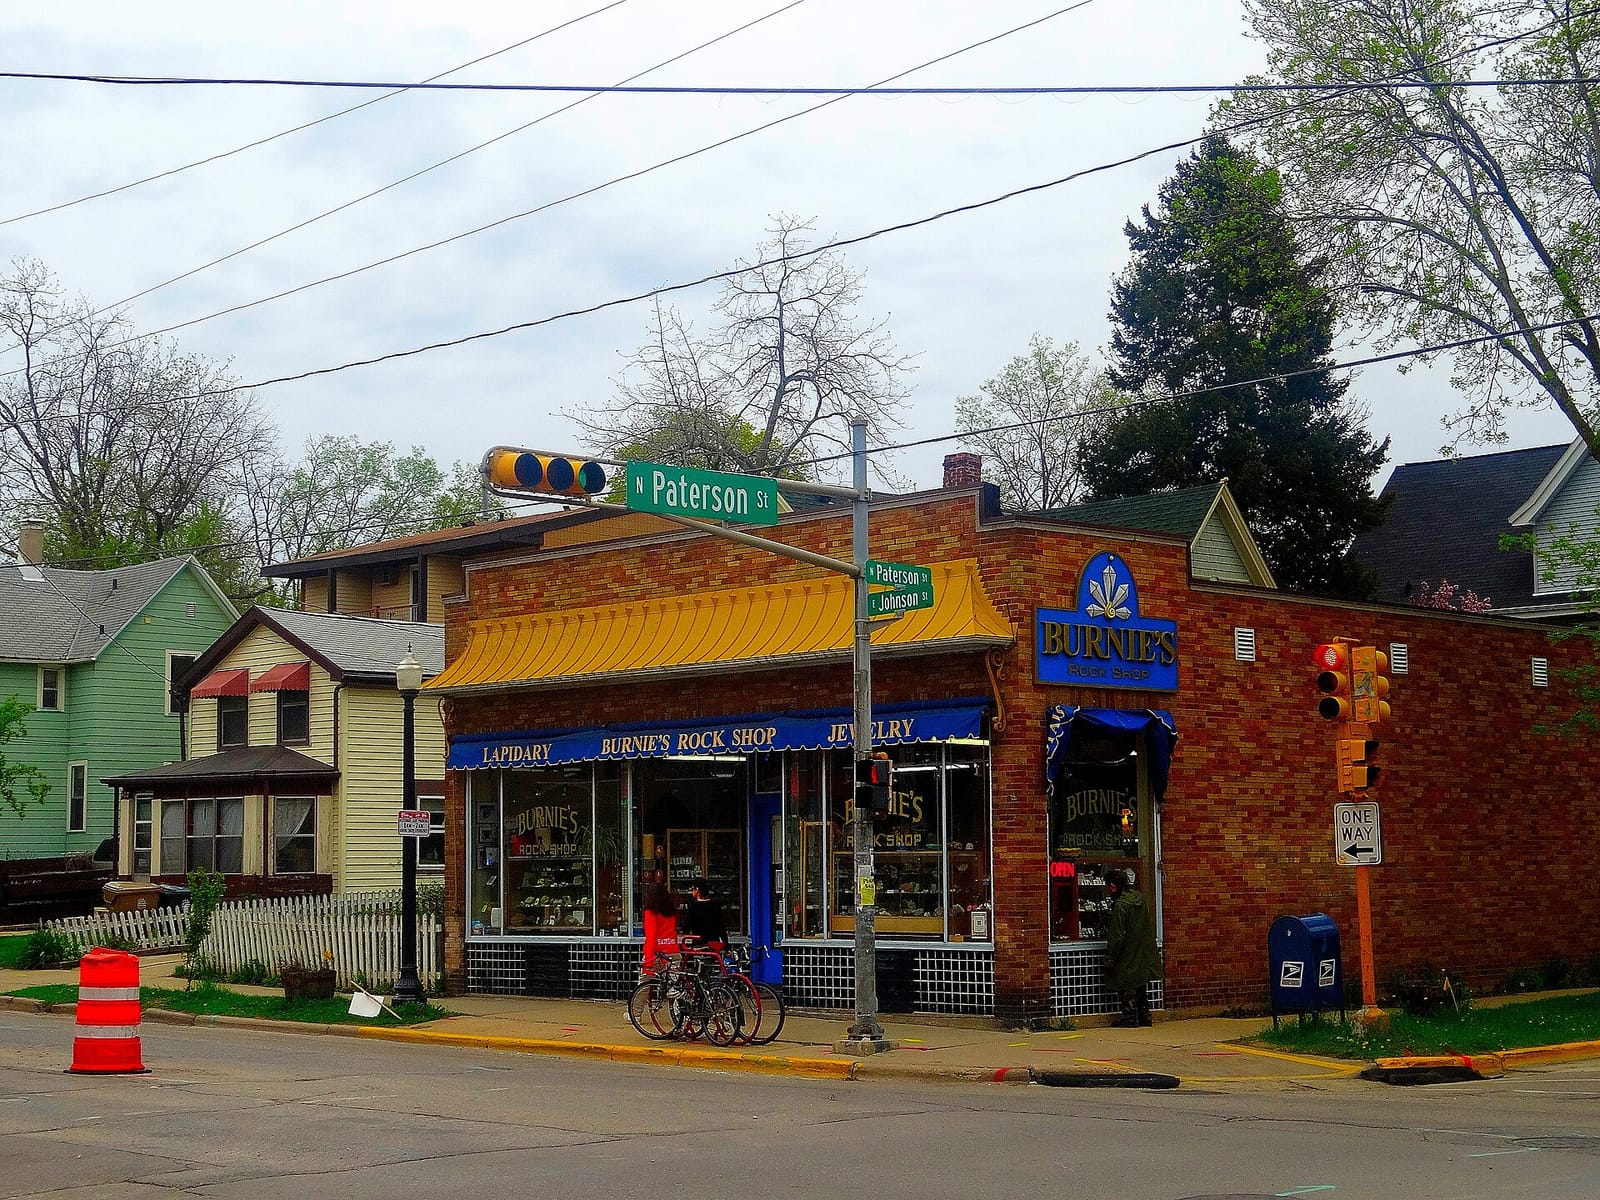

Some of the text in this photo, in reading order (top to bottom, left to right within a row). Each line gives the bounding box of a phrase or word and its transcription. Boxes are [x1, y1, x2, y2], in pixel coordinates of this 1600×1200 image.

[636, 470, 769, 515] N Paterson St
[869, 564, 928, 586] N Paterson St
[872, 591, 928, 612] E Johnson St
[1040, 620, 1176, 664] BURNIE'S
[1068, 663, 1150, 680] ROCK SHOP
[601, 727, 777, 755] BURNIE'S ROCK SHOP
[482, 743, 552, 763] LAPIDARY
[844, 789, 924, 826] BIE'S
[1065, 787, 1137, 823] BURNIE'S
[517, 804, 578, 836] BURNIE'S
[1341, 810, 1373, 825] ONE
[846, 832, 922, 847] RK SHOP
[1341, 826, 1374, 841] WAY
[519, 843, 577, 856] ROCK SHOP
[1050, 862, 1075, 878] OPEN
